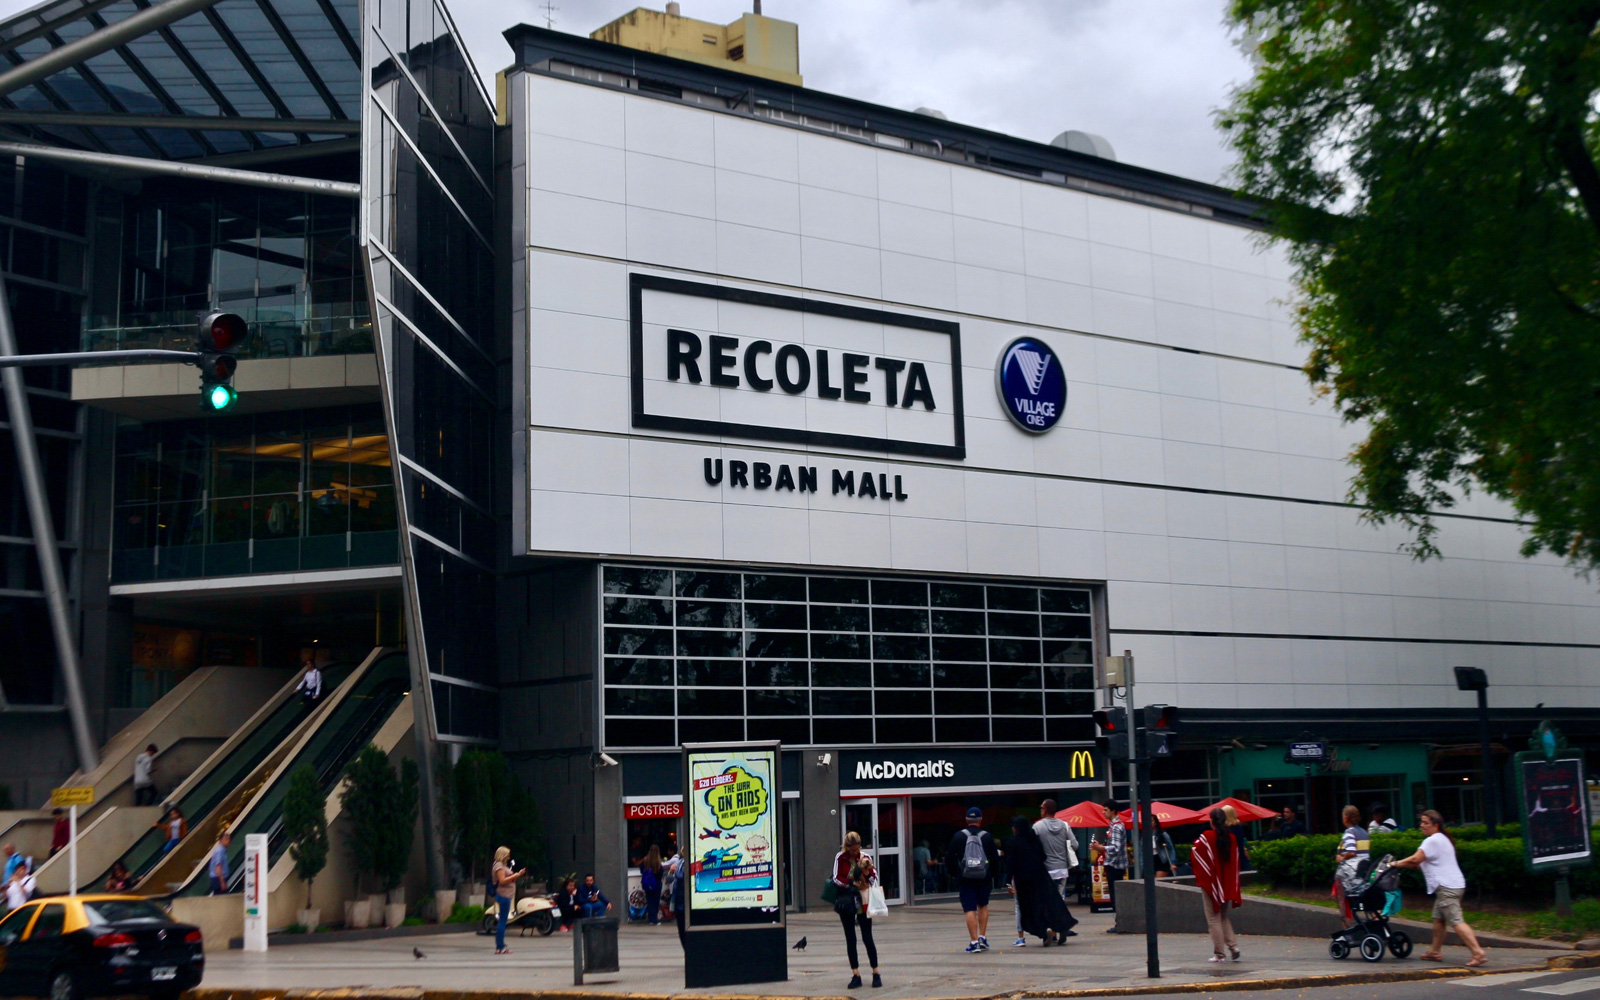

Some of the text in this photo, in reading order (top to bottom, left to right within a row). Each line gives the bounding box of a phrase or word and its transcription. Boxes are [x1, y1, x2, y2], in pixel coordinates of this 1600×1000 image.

[667, 328, 936, 411] RECOLETA
[1015, 398, 1056, 417] VILLAGE
[1026, 414, 1046, 426] CINES
[703, 457, 909, 501] URBAN MALL
[855, 760, 955, 780] McDonald's
[724, 781, 750, 794] THE WAR
[631, 804, 680, 816] POSTRES
[718, 789, 760, 812] ON AIDS
